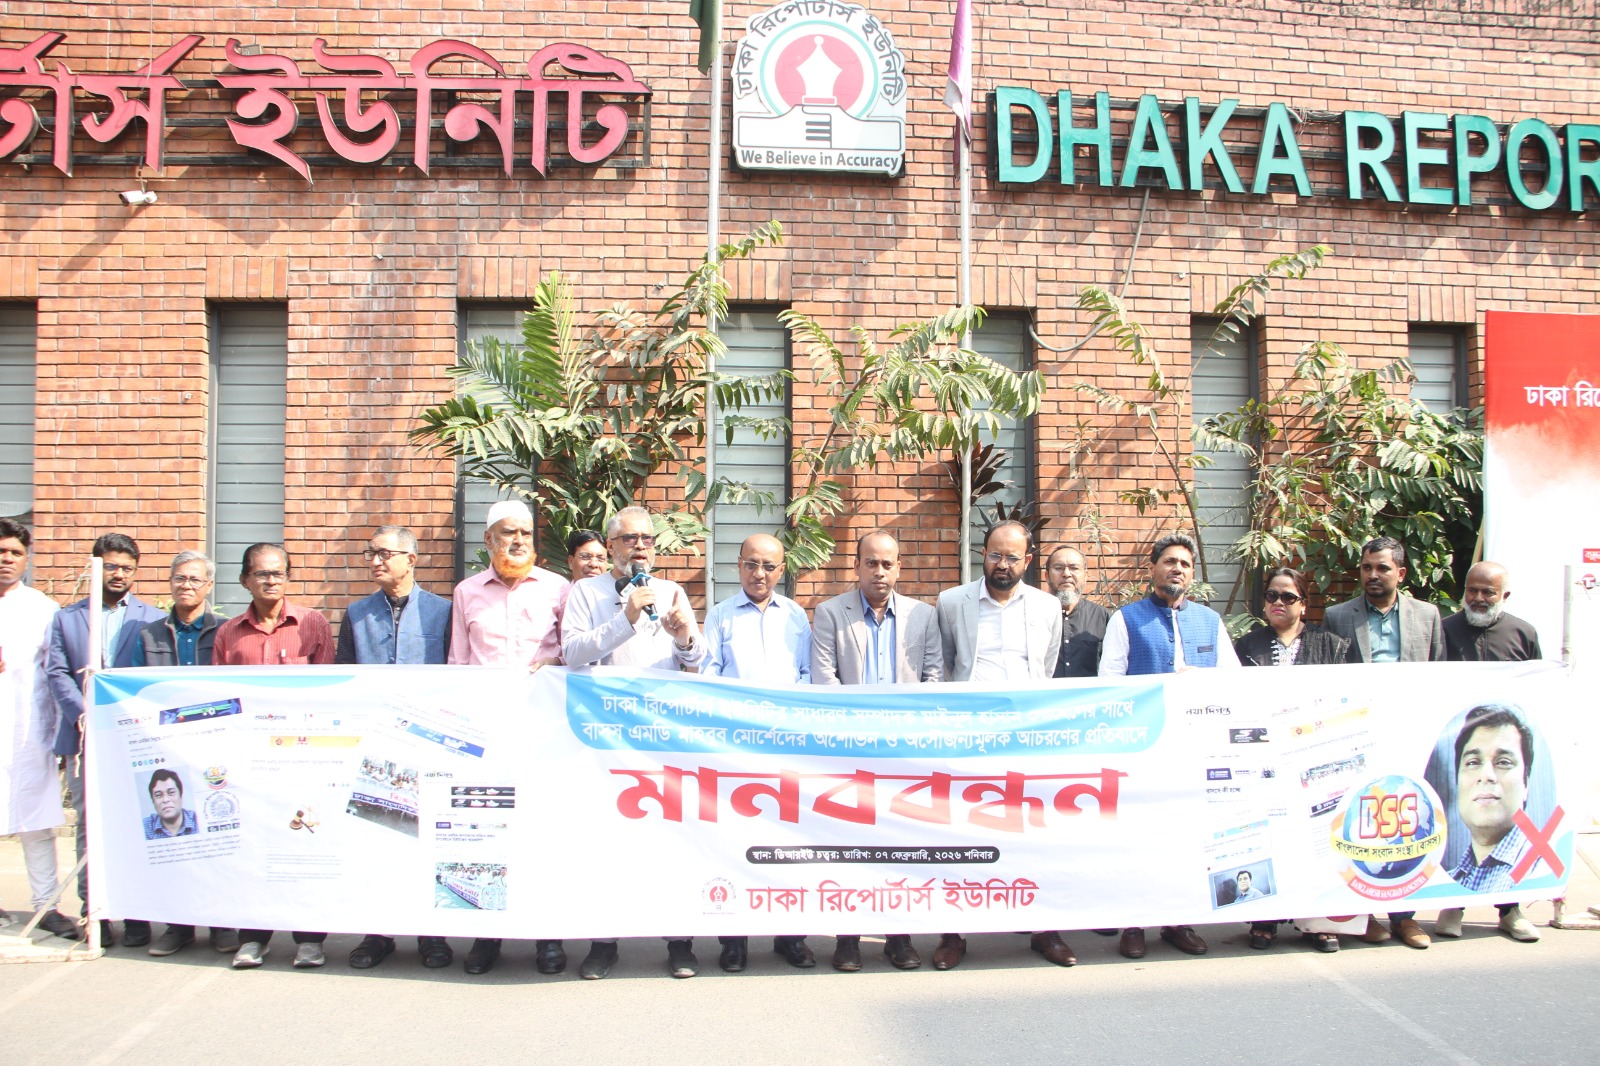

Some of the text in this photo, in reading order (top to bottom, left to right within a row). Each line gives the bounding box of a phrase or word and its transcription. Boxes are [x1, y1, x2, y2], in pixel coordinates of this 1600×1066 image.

[736, 40, 758, 95] ঢাকা
[862, 15, 904, 100] ইউনিটি
[216, 38, 652, 186] ইউনিটি
[992, 86, 1314, 197] DHAKA
[741, 149, 899, 171] We Believe in Accuracy
[1523, 385, 1570, 407] ঢাকা
[601, 695, 638, 715] ঢাকা
[792, 706, 847, 724] সাধারণ
[1101, 698, 1136, 718] সাথে
[581, 721, 624, 741] বাসস
[628, 719, 672, 742] এমডি
[733, 723, 808, 747] মোর্শেদের
[813, 730, 880, 749] অশোভন
[885, 732, 898, 748] ও
[1016, 728, 1080, 748] আচরণের
[1085, 722, 1149, 746] প্রতিবাদে
[609, 765, 1129, 834] মানববন্ধন
[1359, 794, 1419, 838] BSS
[752, 850, 772, 861] স্থান:
[842, 849, 871, 860] তারিখ:
[875, 851, 888, 860] ০৭
[934, 851, 961, 860] ২০২৬
[963, 849, 993, 860] শনিবার
[745, 886, 810, 913] ঢাকা
[816, 877, 937, 913] রিপোর্টার্স
[941, 877, 1040, 912] ইউনিটি
